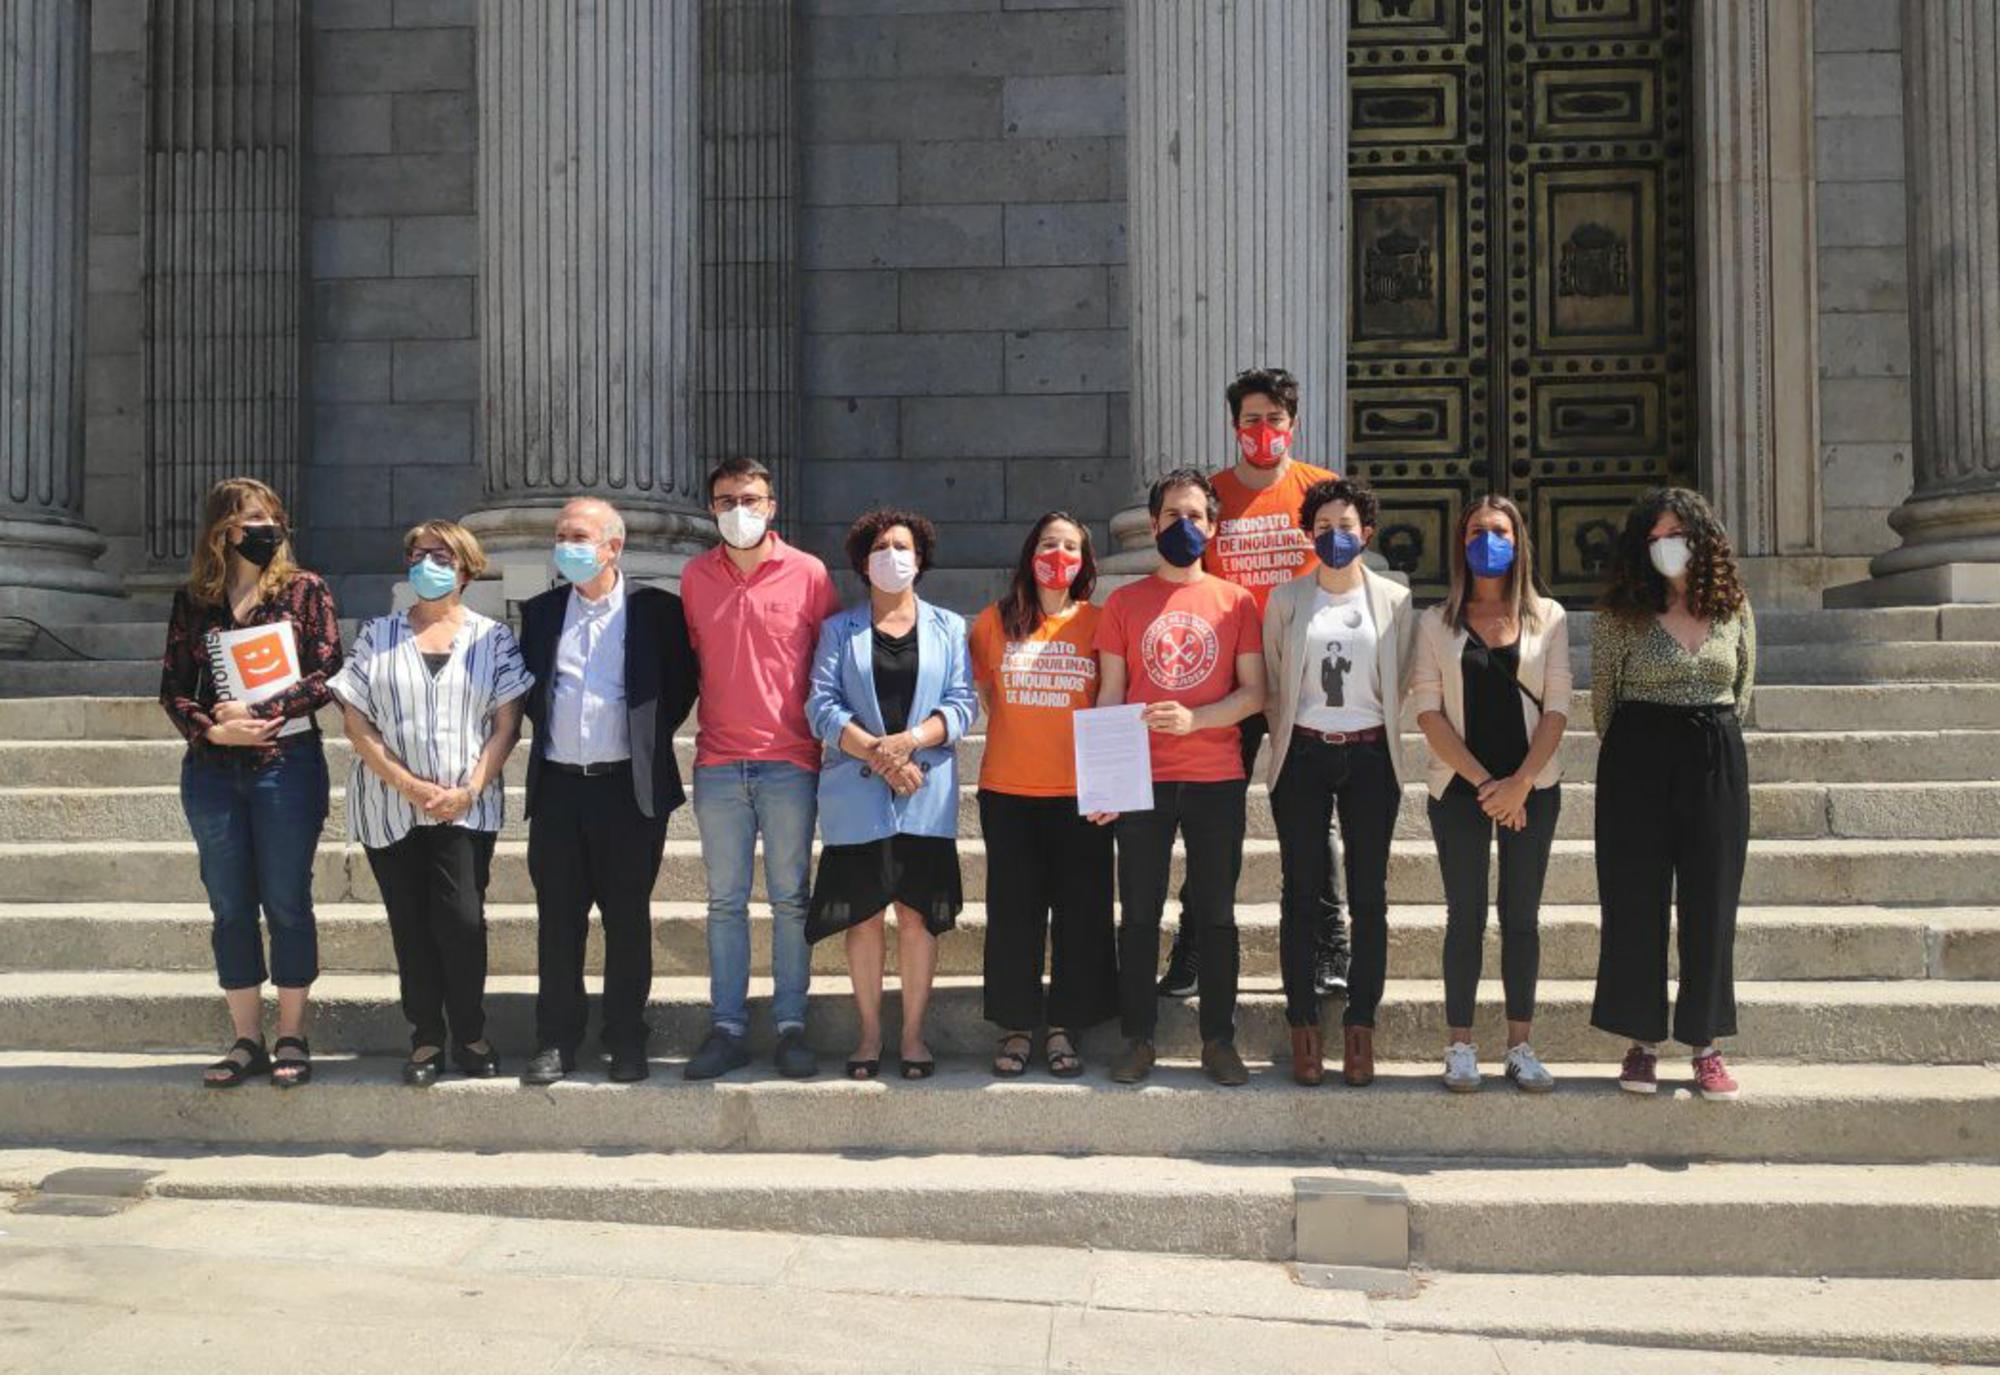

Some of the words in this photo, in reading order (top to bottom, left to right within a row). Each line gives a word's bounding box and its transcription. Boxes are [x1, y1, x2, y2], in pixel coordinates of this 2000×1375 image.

[1220, 514, 1290, 533] SINDICATO
[1219, 537, 1237, 553] DE
[1238, 529, 1308, 551] INQUILINA
[1222, 558, 1229, 572] E
[1231, 551, 1305, 572] INQUILINOS
[1240, 569, 1292, 587] MADRID
[1006, 641, 1076, 654] SINDICATO
[1022, 656, 1096, 676] INQUILINAS
[1004, 674, 1011, 688] E
[1012, 672, 1086, 692] INQUILINOS
[1020, 690, 1071, 707] MADRID
